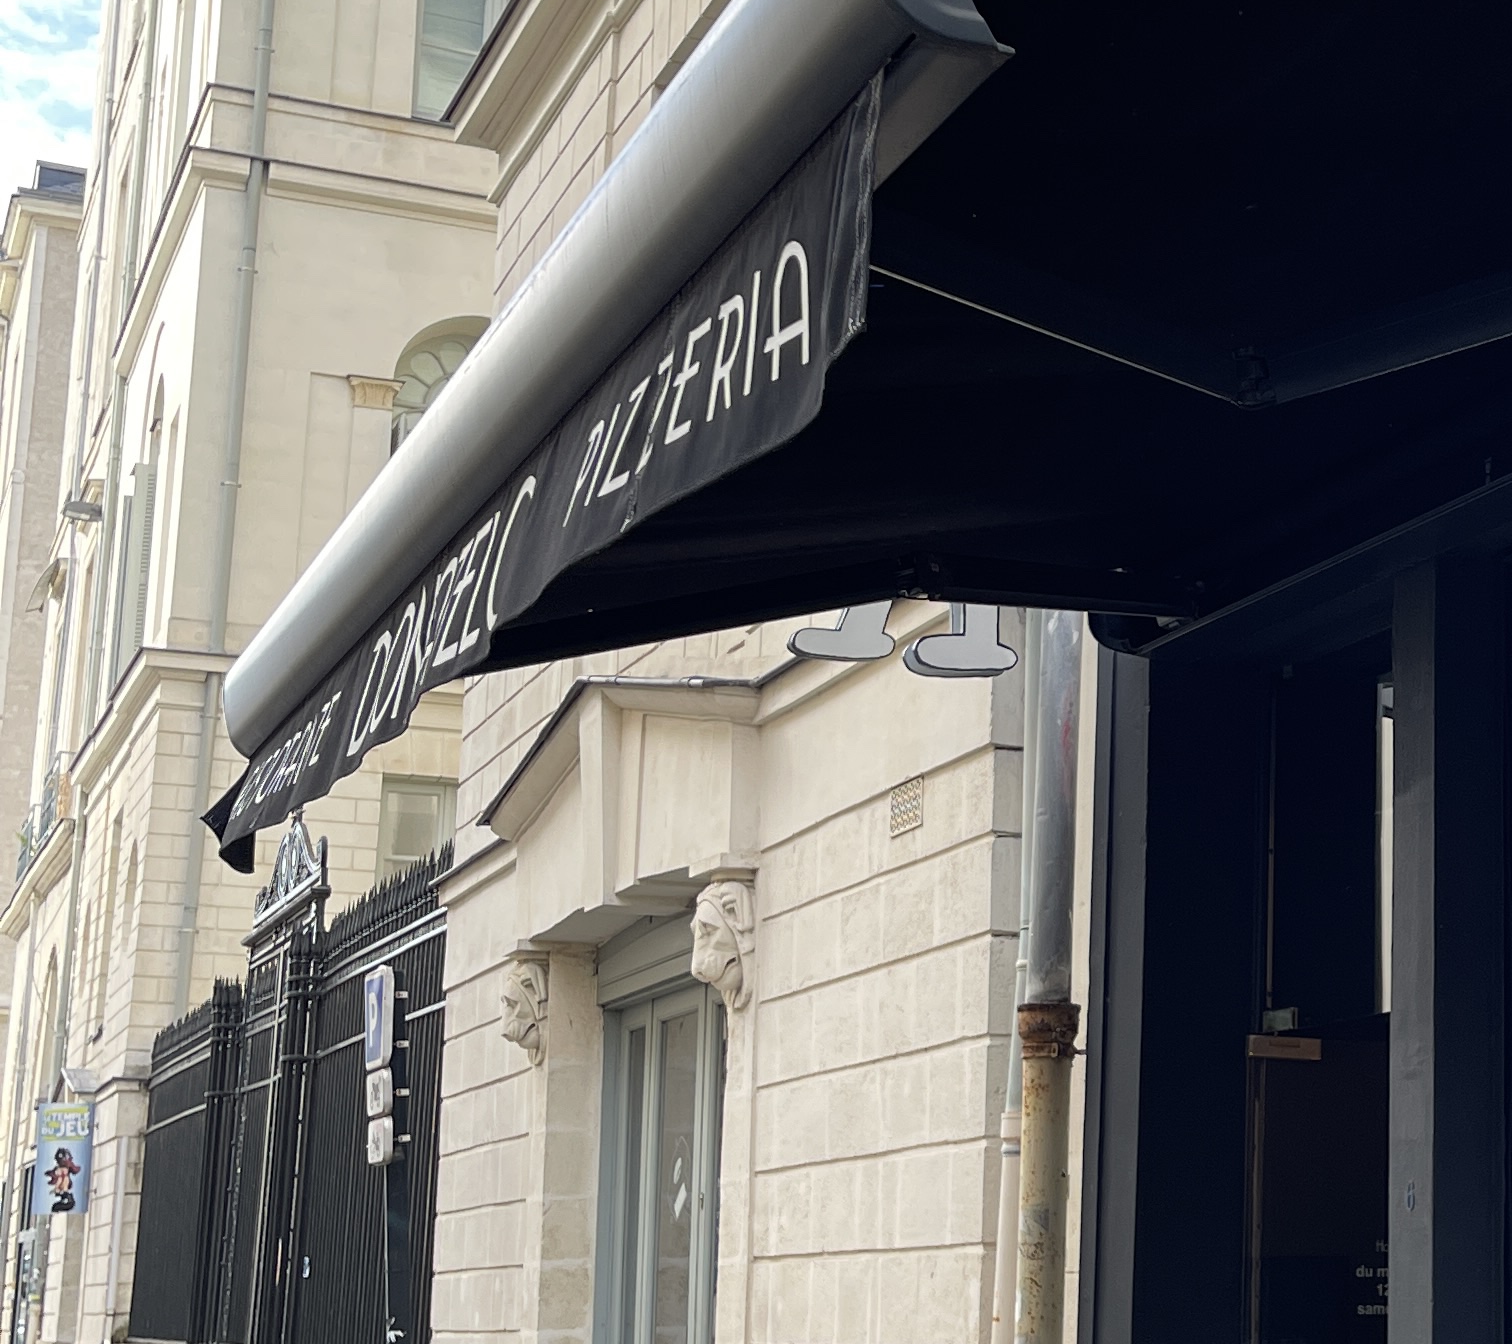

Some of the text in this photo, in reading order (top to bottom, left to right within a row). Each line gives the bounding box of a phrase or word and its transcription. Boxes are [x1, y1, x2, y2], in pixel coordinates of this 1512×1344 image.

[562, 240, 810, 527] PIZZERIA
[368, 992, 378, 1047] P
[57, 1120, 90, 1136] JEU
[1355, 1264, 1374, 1278] du
[1357, 1304, 1389, 1316] sam
